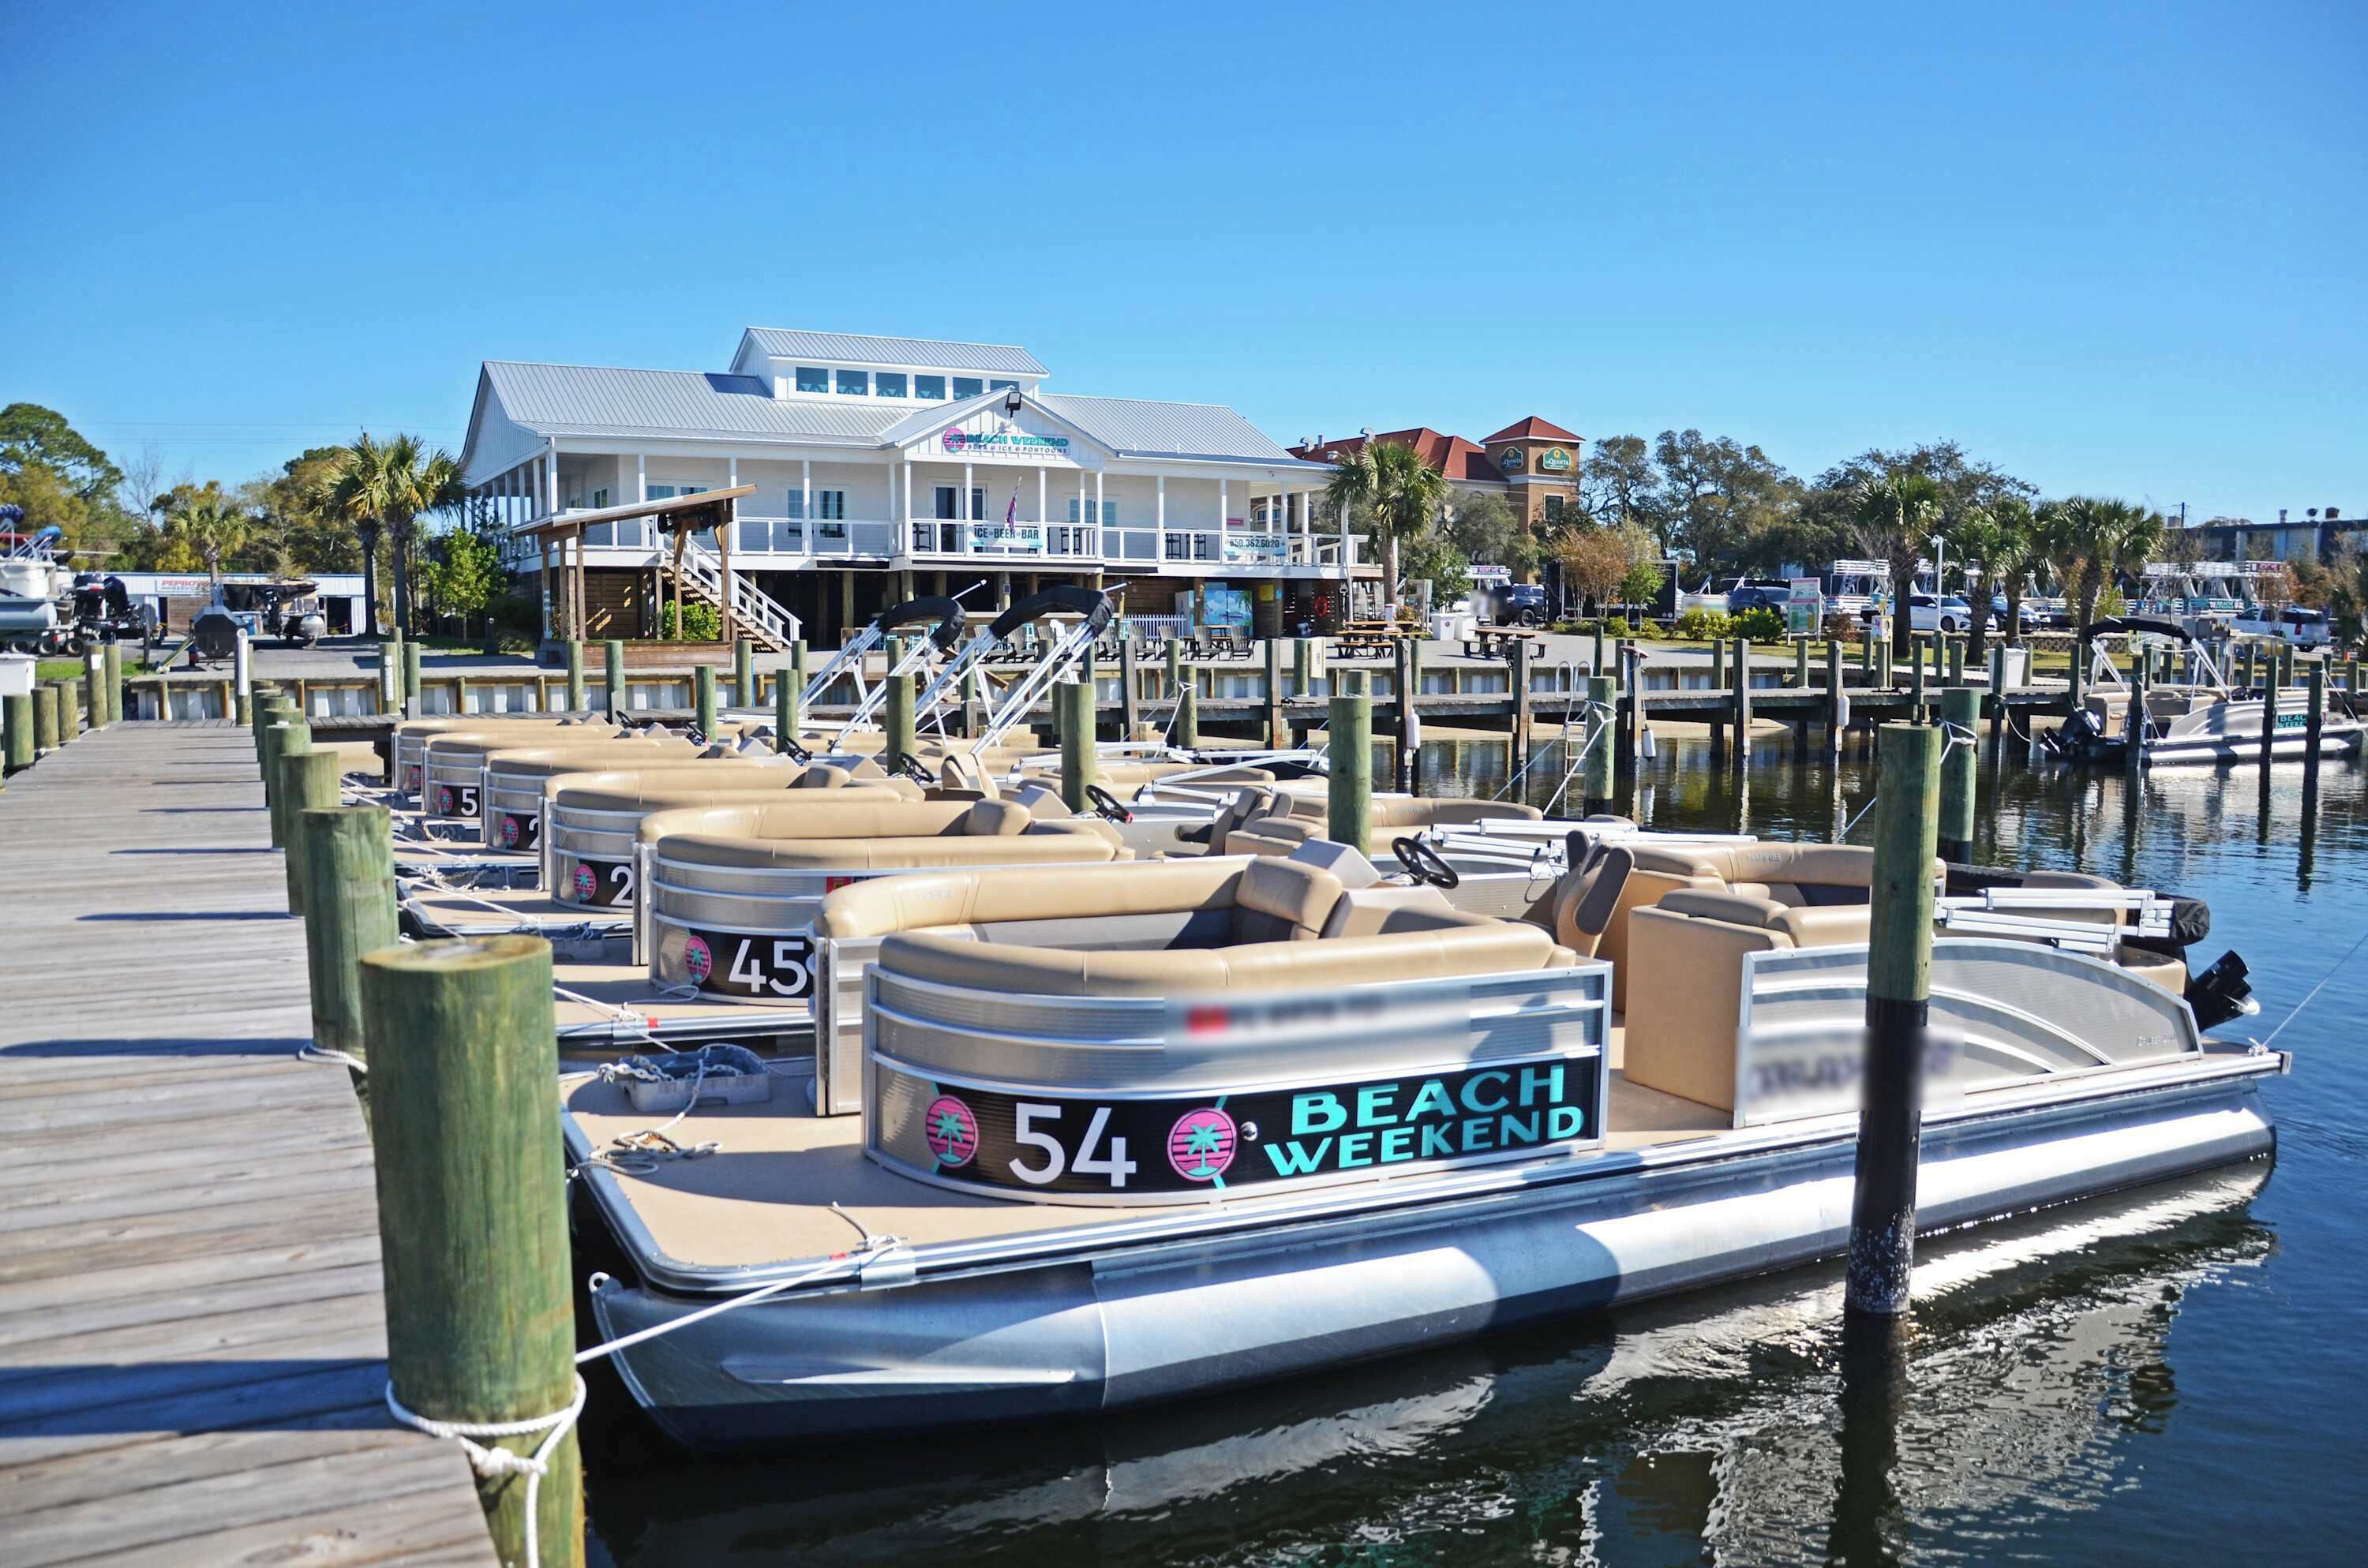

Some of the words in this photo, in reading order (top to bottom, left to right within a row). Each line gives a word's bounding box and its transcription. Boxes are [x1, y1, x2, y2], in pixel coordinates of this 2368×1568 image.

[966, 435, 1007, 445] BEACH
[1011, 436, 1069, 447] WEEKEND
[974, 527, 988, 538] ICE
[994, 528, 1015, 539] BEER
[1021, 530, 1039, 539] BAR
[729, 939, 807, 995] 45
[1291, 1064, 1564, 1136] BEACH
[1009, 1102, 1137, 1187] 54
[1264, 1106, 1585, 1177] WEEKEND
